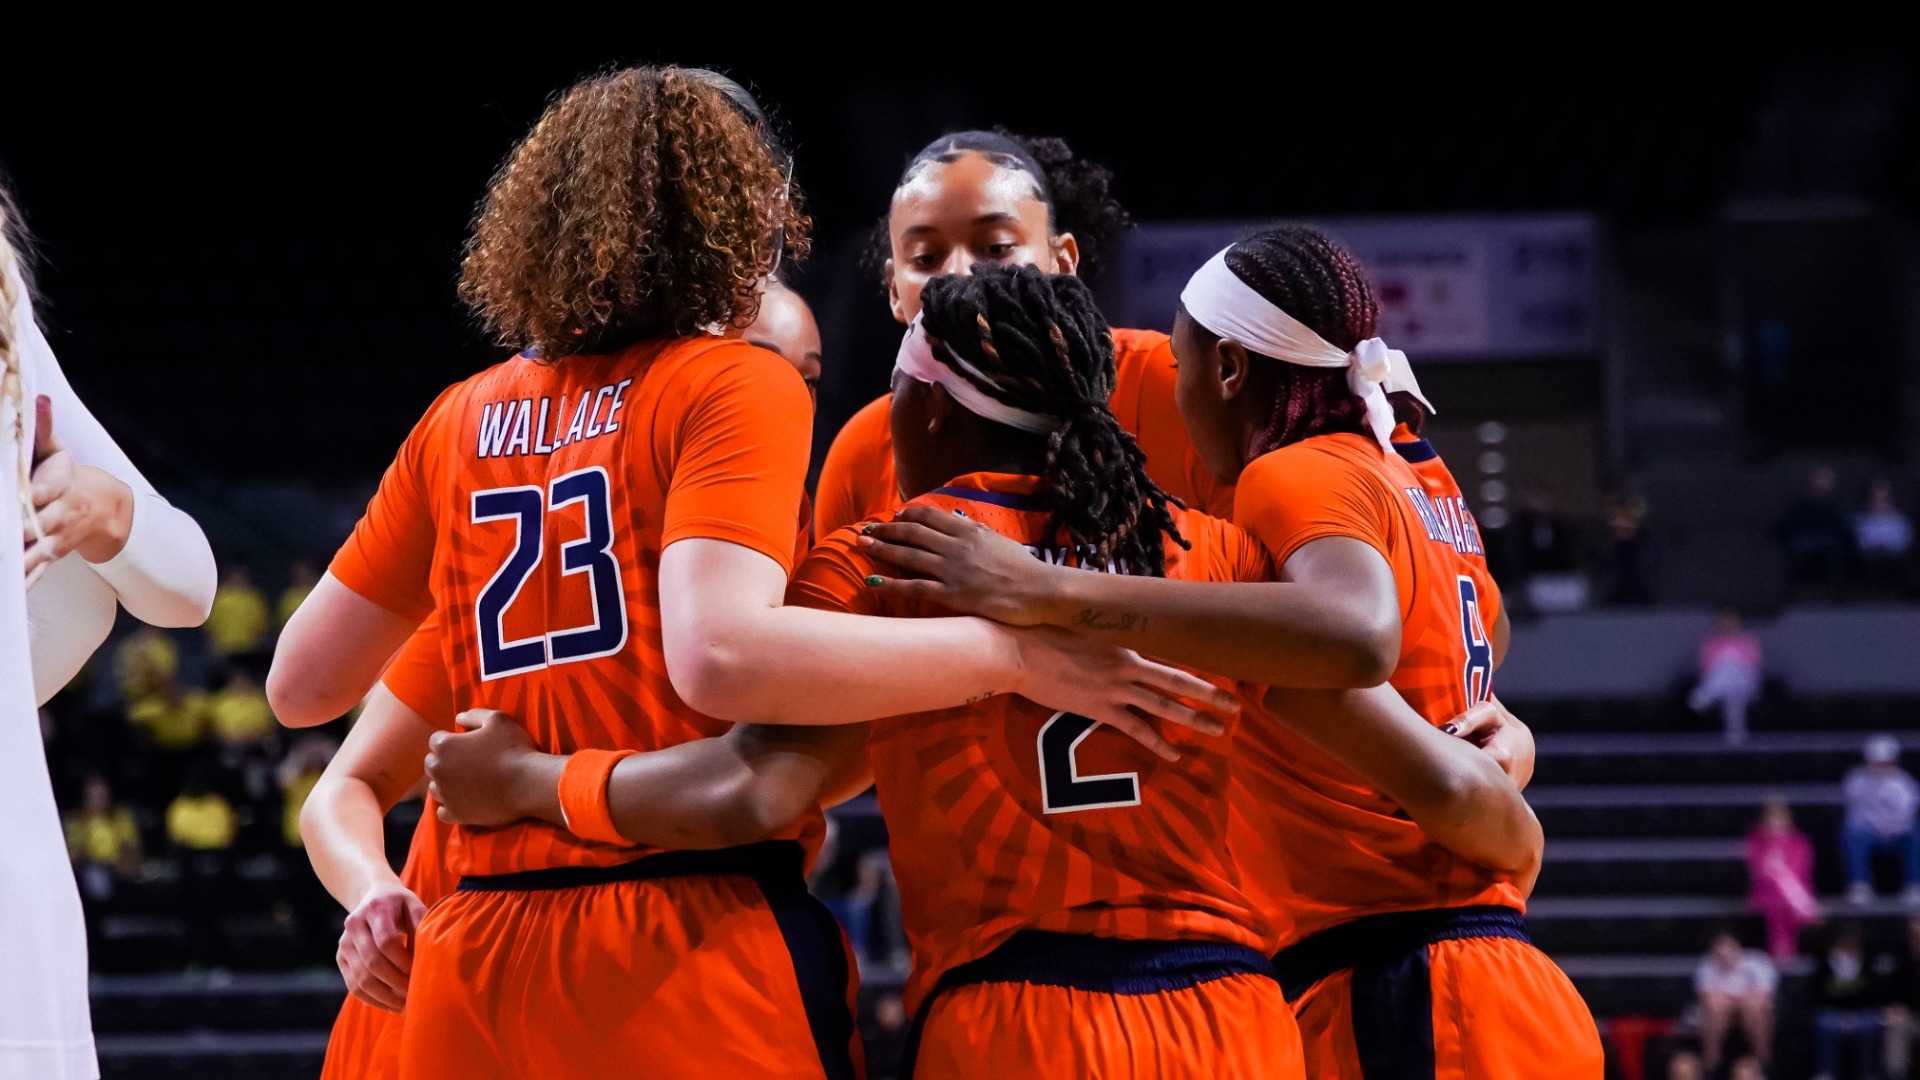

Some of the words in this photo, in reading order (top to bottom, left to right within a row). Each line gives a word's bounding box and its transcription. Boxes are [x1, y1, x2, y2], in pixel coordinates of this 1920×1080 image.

[477, 378, 632, 459] WALLACE
[471, 465, 628, 682] 23
[1457, 575, 1494, 709] 8
[1037, 711, 1142, 814] 2
